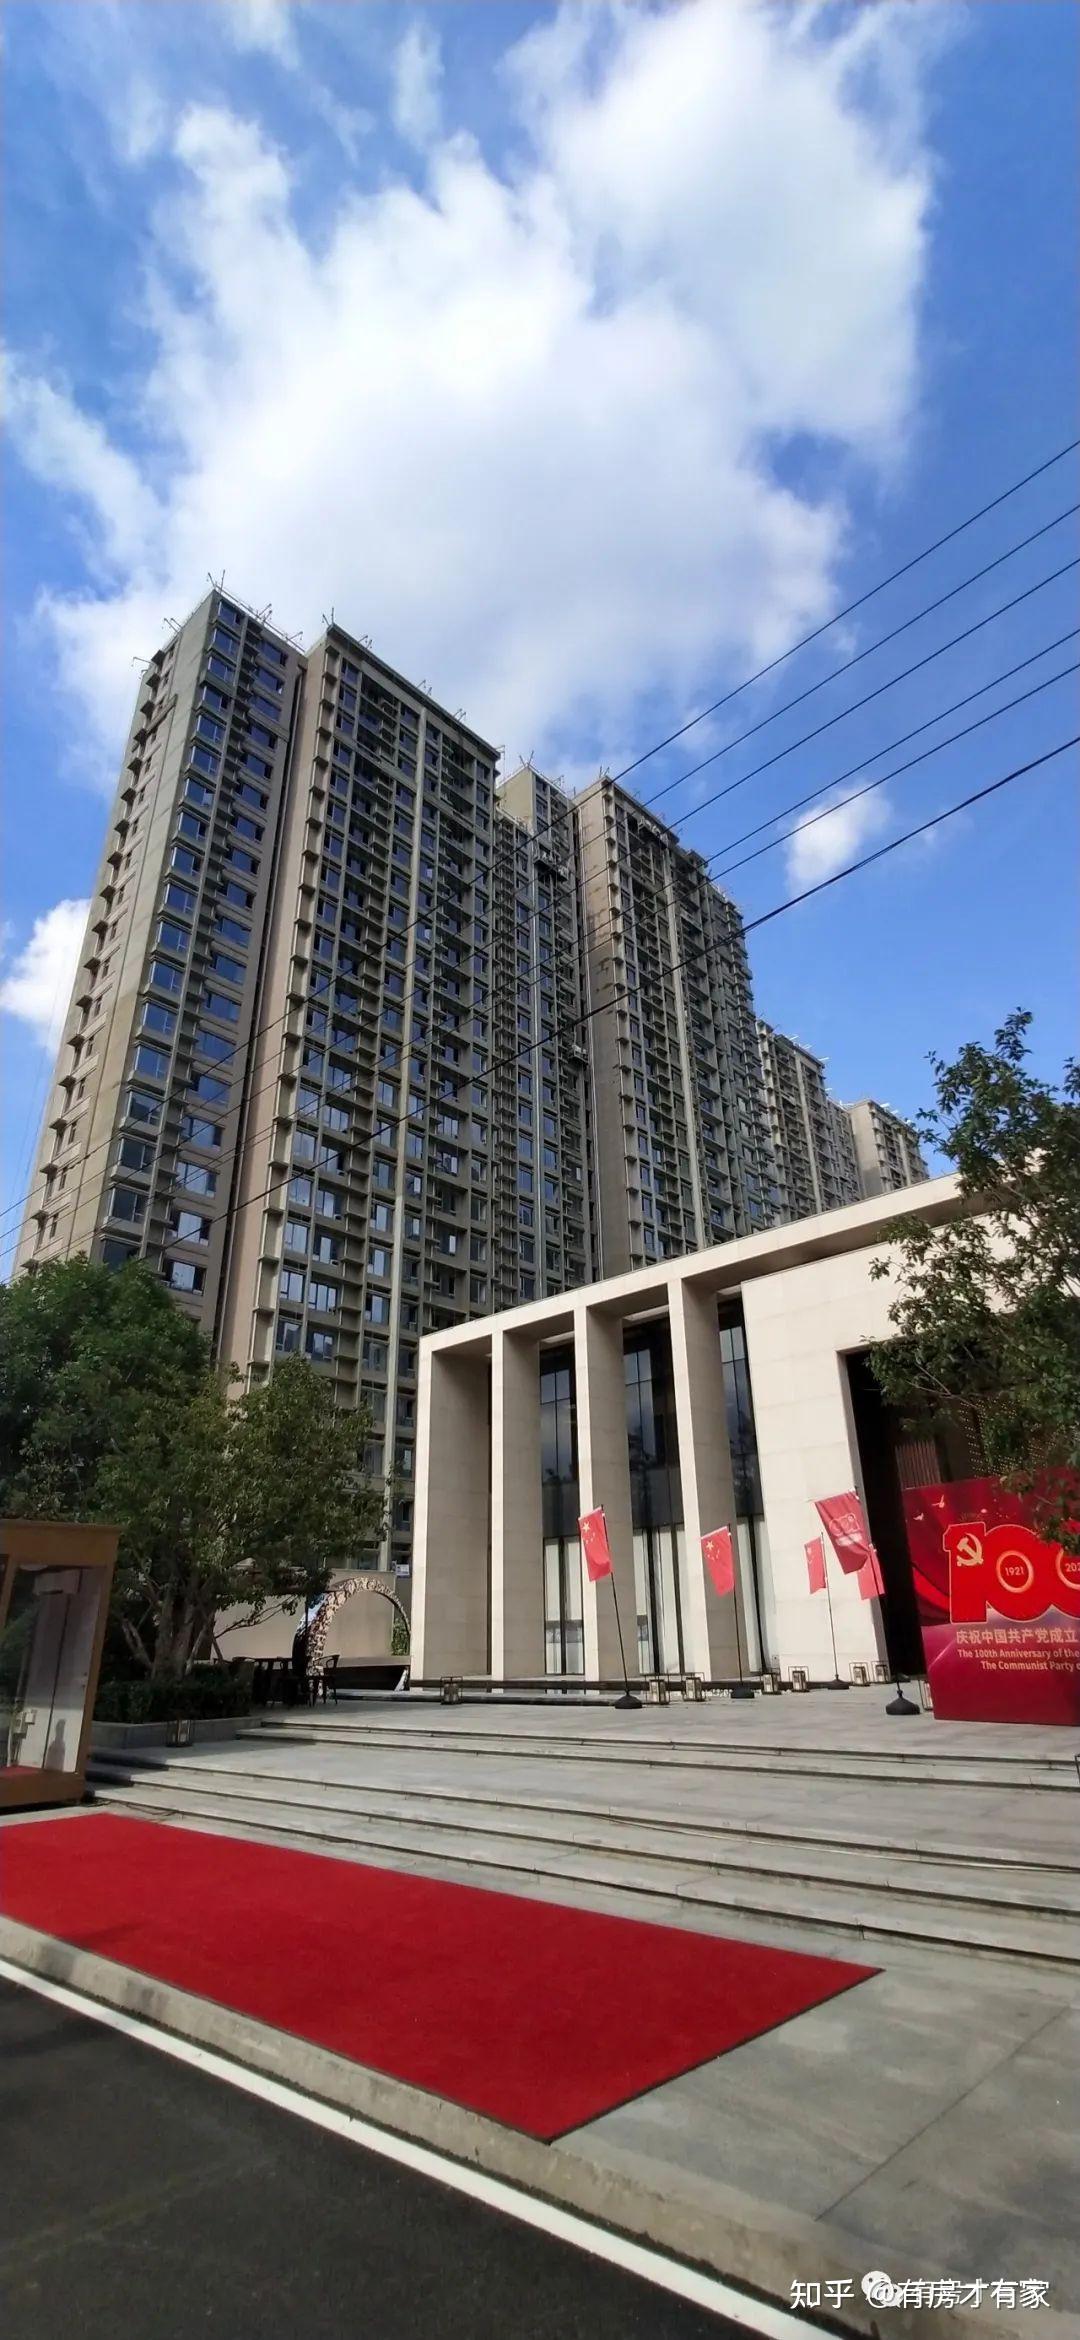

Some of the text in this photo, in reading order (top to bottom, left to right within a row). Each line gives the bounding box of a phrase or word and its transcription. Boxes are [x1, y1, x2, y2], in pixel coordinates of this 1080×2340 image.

[1005, 1566, 1024, 1576] 1921
[956, 1627, 1078, 1644] 庆祝中国共产党成立
[957, 1648, 1080, 1660] The 100th Anniversary of the
[981, 1661, 996, 1670] The
[998, 1661, 1048, 1670] Communist
[1049, 1661, 1074, 1672] Party
